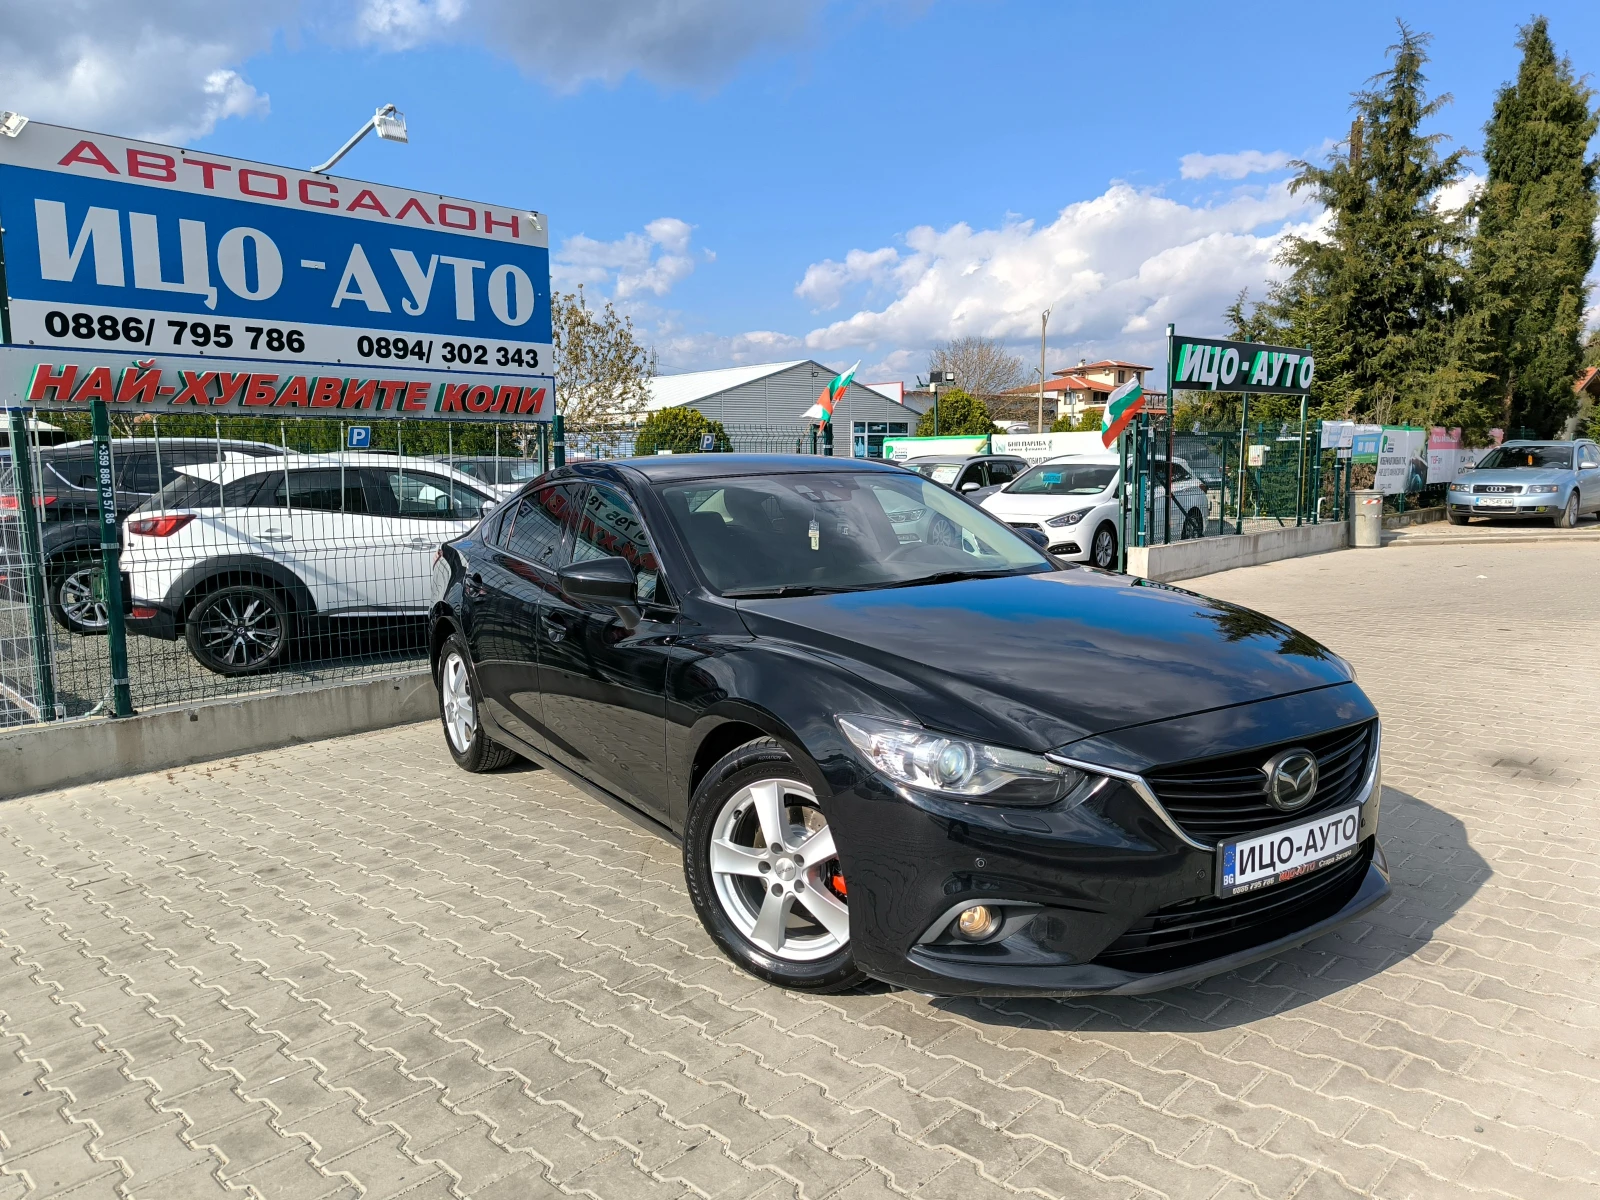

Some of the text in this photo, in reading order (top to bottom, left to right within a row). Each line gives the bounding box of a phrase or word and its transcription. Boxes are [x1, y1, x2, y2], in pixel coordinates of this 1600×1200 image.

[58, 140, 520, 238] АВТОСАЛОН
[44, 310, 539, 369] 0886/ 795 786 0894/ 302 343
[27, 359, 547, 415] НАЙ-ХУБАВИТЕ КОЛИ
[353, 428, 366, 445] P
[99, 444, 116, 524] +359 886 79 57 86
[1239, 814, 1357, 876] ИЦО-АУТО
[1223, 873, 1235, 887] BG
[1250, 880, 1262, 890] 795
